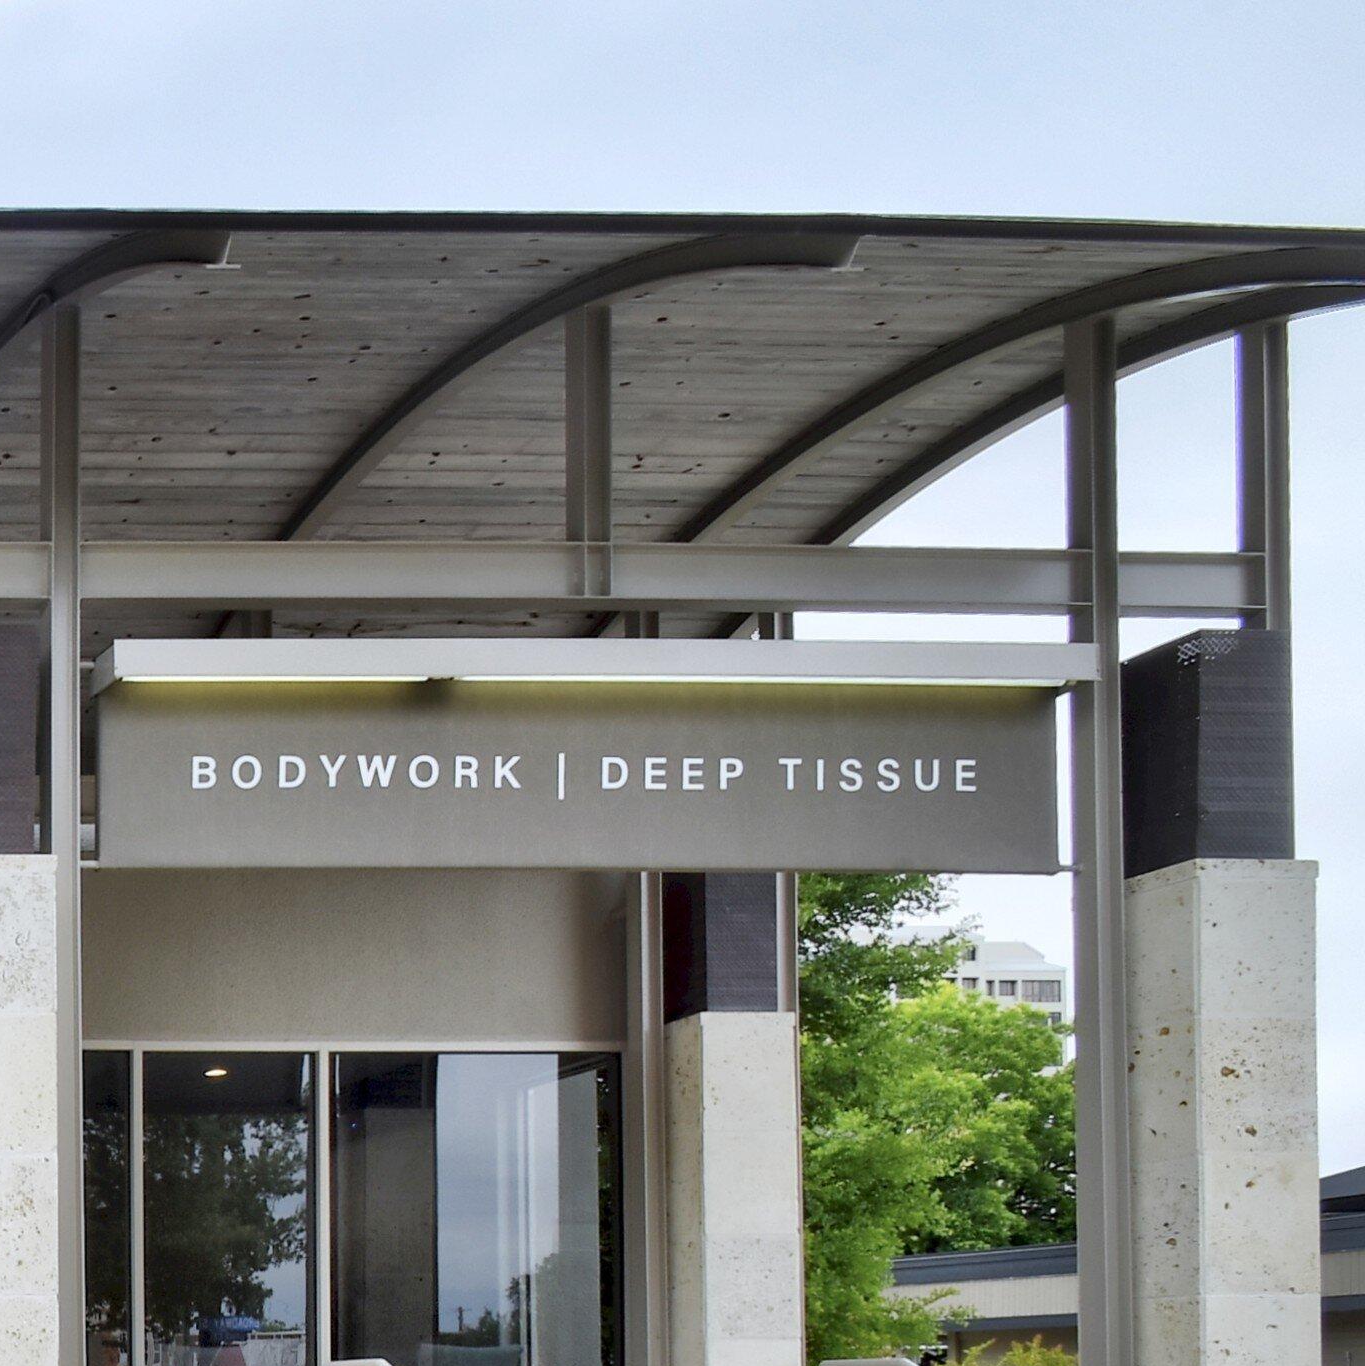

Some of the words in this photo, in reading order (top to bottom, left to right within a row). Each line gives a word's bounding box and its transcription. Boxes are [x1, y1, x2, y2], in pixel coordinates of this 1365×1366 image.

[190, 753, 522, 790] BODYWORK
[600, 755, 746, 791] DEEP
[777, 757, 977, 793] TISSUE
